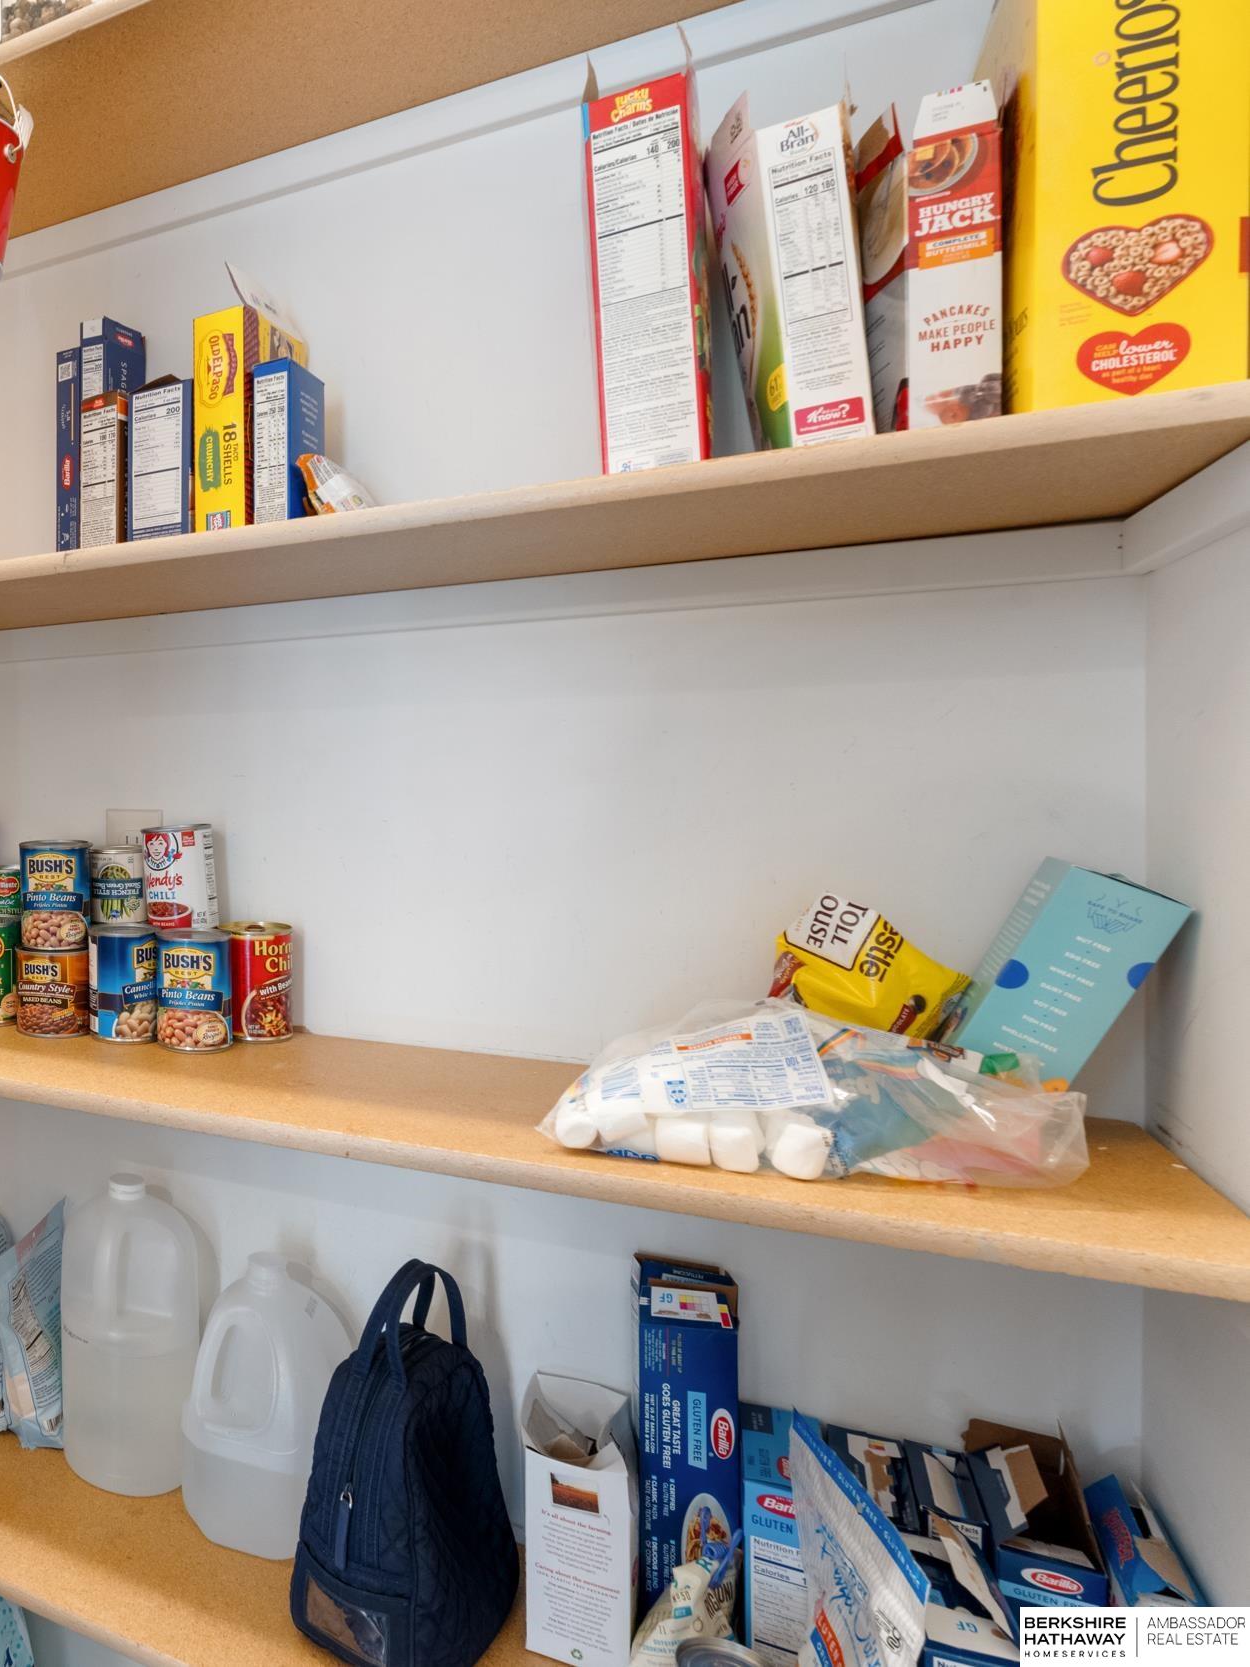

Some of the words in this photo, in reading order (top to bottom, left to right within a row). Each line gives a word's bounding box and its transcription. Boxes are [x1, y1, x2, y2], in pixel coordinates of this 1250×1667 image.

[646, 145, 659, 155] 140
[667, 139, 679, 149] 200
[780, 136, 814, 152] Bran
[772, 159, 807, 174] Nutrition
[809, 152, 832, 162] Facts
[775, 193, 798, 204] Calories
[804, 184, 818, 194] 120
[918, 192, 995, 219] HUNGRY
[914, 203, 996, 237] JACK
[924, 303, 991, 326] PANCAKES
[918, 326, 949, 342] MAKE
[953, 319, 996, 336] PEOPLE
[931, 335, 984, 352] HAPPY
[1095, 341, 1117, 352] CAN
[1119, 336, 1174, 356] lower
[1091, 349, 1178, 372] CHOLESTEROL
[1094, 348, 1118, 359] HELP
[135, 391, 161, 400] Nutrition
[135, 413, 156, 421] Calories
[166, 406, 180, 415] 200
[223, 422, 237, 443] 18
[206, 436, 214, 483] CRUNCHY
[223, 444, 233, 486] SHELLS
[29, 859, 74, 875] BUSH'S
[26, 893, 47, 902] Pinto
[50, 893, 76, 902] Beans
[149, 891, 176, 899] CHILI
[136, 946, 157, 964] BUS
[1092, 942, 1111, 953] FREE
[24, 963, 58, 976] BUSH'S
[164, 953, 212, 971] BUSH'S
[1049, 965, 1076, 980] WHEAT
[1076, 977, 1095, 987] FREE
[18, 983, 46, 992] Country
[48, 984, 70, 993] Style
[161, 989, 183, 999] Pinto
[185, 991, 216, 1001] Beans
[260, 985, 277, 995] with
[785, 1056, 799, 1067] 100
[659, 1292, 673, 1303] GF
[662, 1383, 670, 1407] GOES
[672, 1400, 680, 1427] GREAT
[693, 1398, 701, 1434] GLUTEN
[662, 1409, 670, 1442] GLUTEN
[672, 1430, 680, 1455] TASTE
[717, 1420, 729, 1455] Barilla
[662, 1445, 670, 1469] FREE!
[693, 1438, 702, 1464] FREE
[751, 1515, 793, 1535] GLUTEN
[753, 1538, 794, 1554] Nutrition
[753, 1564, 790, 1581] Calories
[1035, 1573, 1078, 1592] Barilla
[1013, 1587, 1058, 1606] GLUTEN
[957, 1620, 979, 1633] GF
